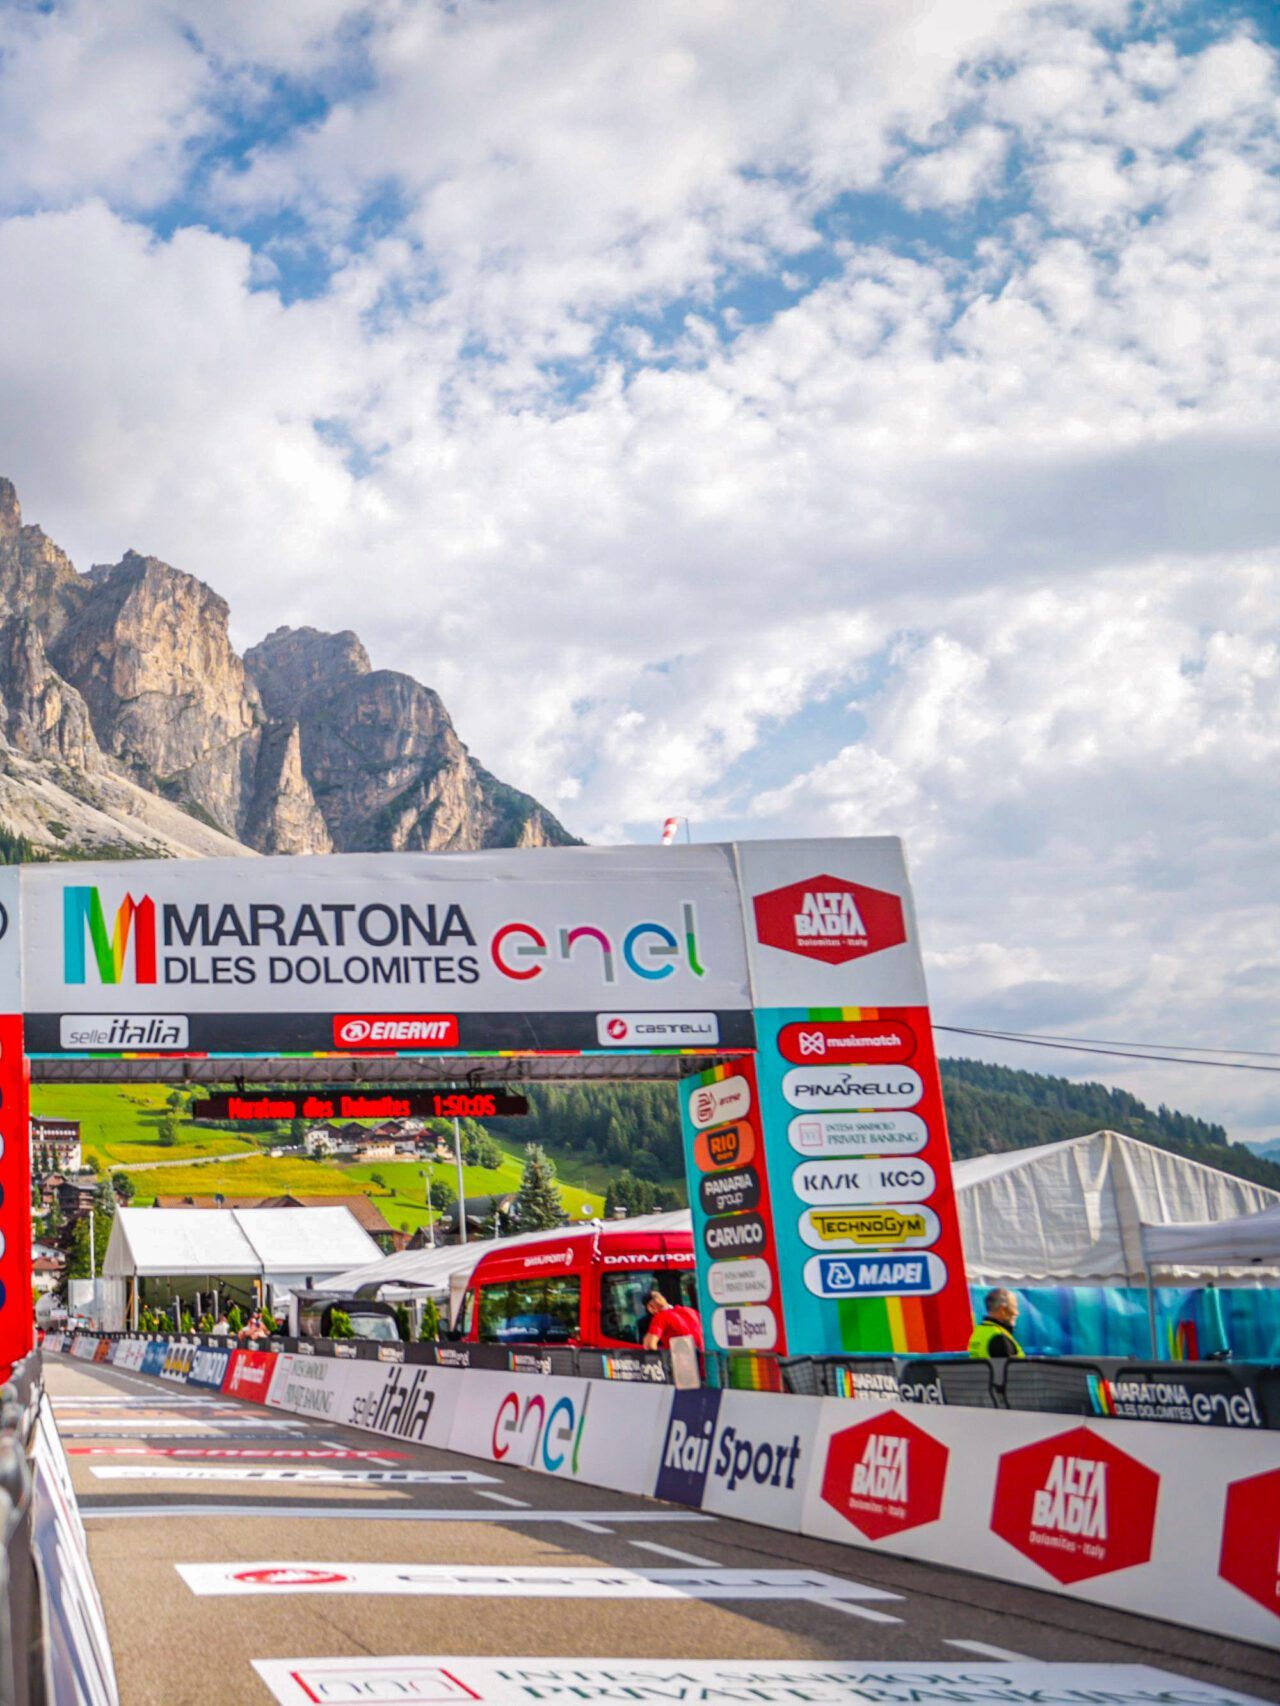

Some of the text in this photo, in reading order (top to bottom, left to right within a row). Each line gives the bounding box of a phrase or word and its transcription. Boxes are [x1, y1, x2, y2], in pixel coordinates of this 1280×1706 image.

[801, 892, 858, 914] ALTA
[162, 904, 477, 947] MARATONA
[794, 914, 867, 936] BADIA
[490, 903, 705, 983] enel
[163, 955, 479, 985] DLES DOLOMITES
[370, 1021, 450, 1041] ENERVIT
[794, 1077, 915, 1098] PINARELLO
[710, 1133, 736, 1153] RIO
[705, 1222, 763, 1251] CARVICO
[858, 1262, 923, 1287] MAPEI
[900, 1377, 944, 1405] enel
[1109, 1382, 1190, 1405] MARATONA
[1191, 1387, 1261, 1426] enel
[492, 1382, 593, 1477] enel
[664, 1419, 801, 1491] Rai Sport
[861, 1434, 909, 1468] ALTA
[851, 1462, 909, 1504] BADIA
[1044, 1455, 1109, 1499] ALTA
[1031, 1490, 1109, 1541] BADIA
[1028, 1530, 1106, 1560] Dolomites Italy
[520, 1685, 1242, 1706] PRIVATE BANKING
